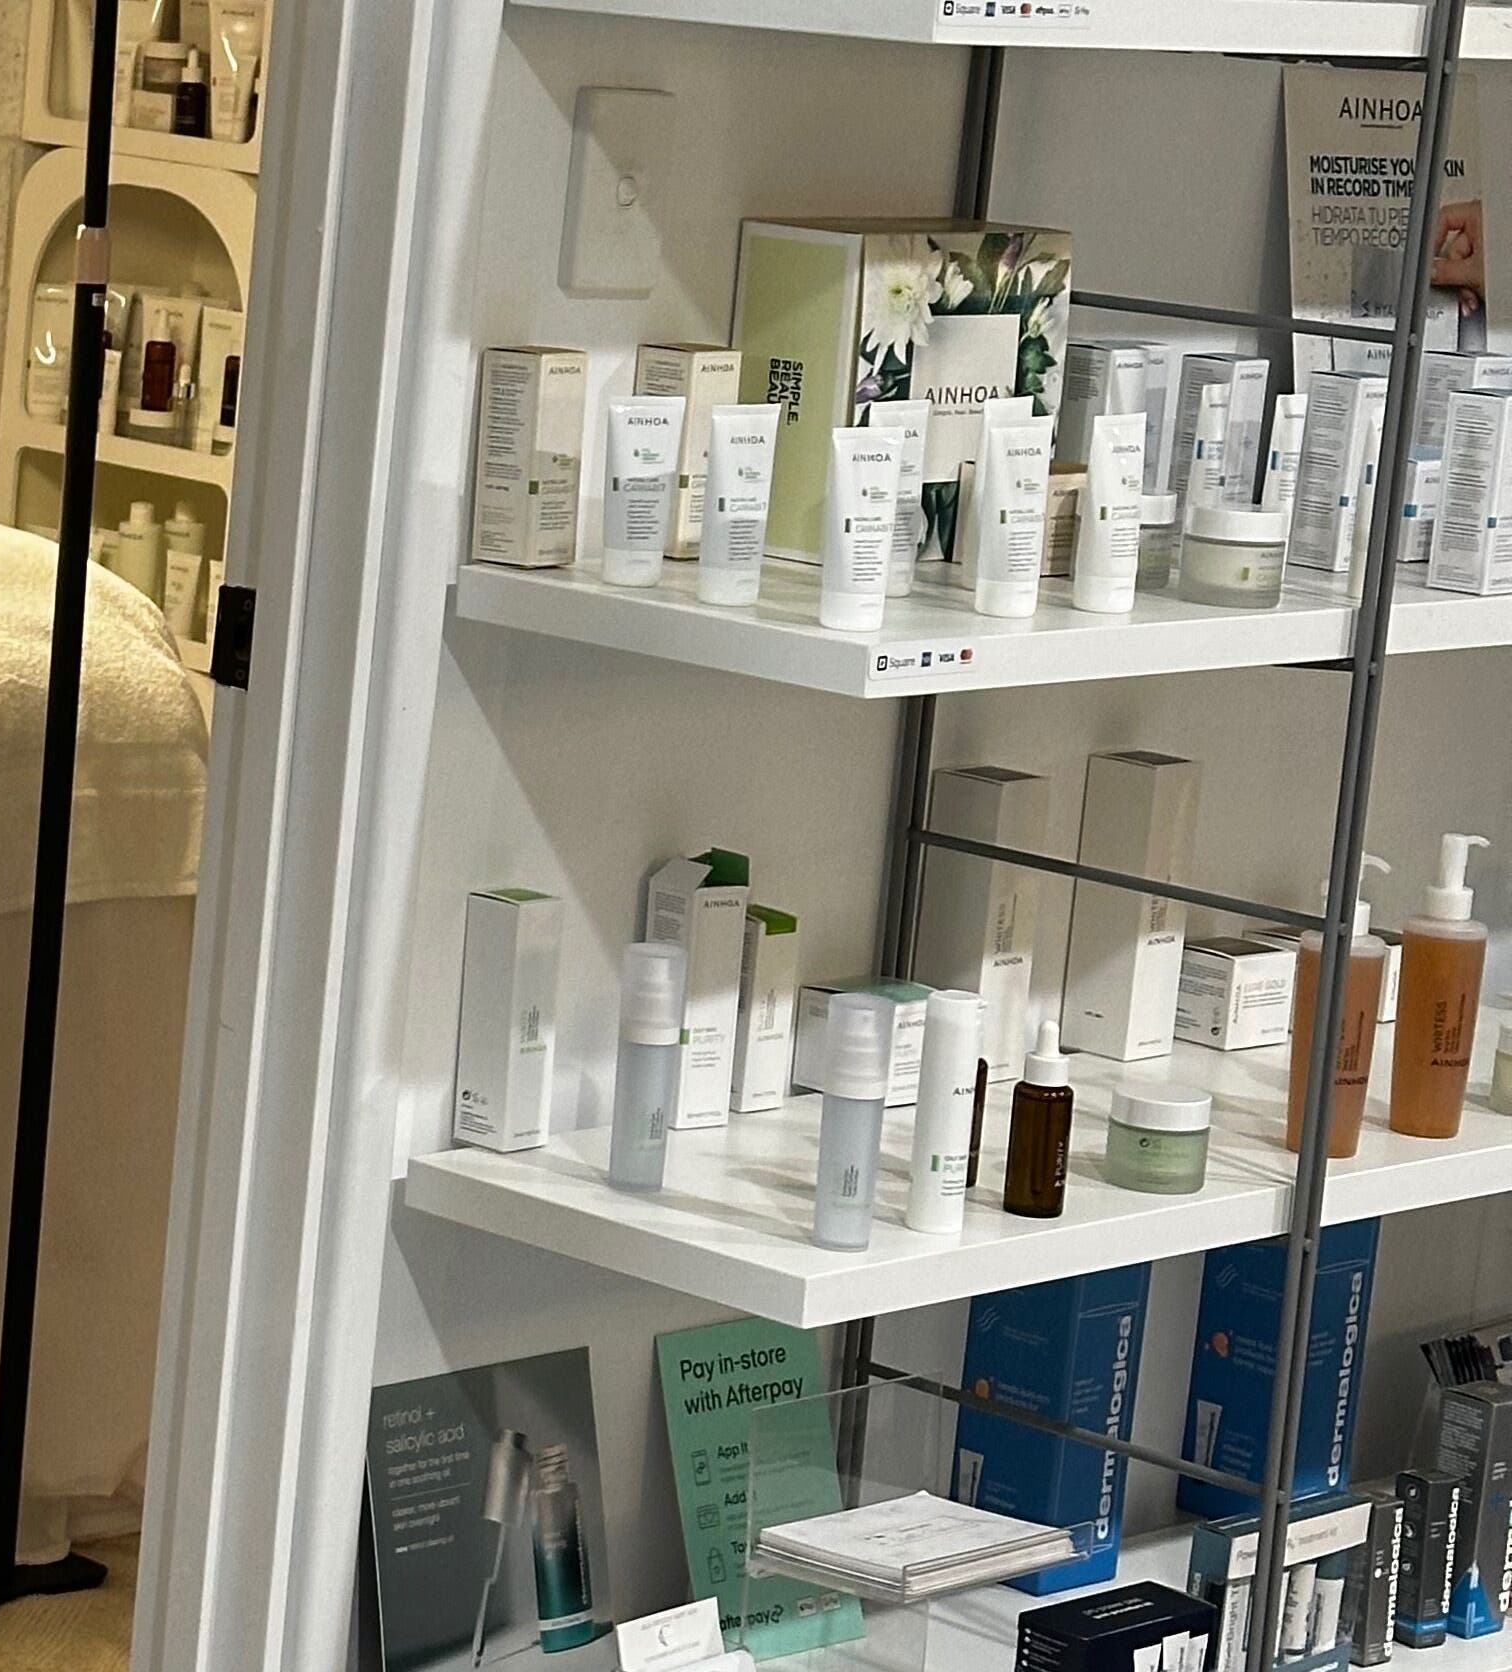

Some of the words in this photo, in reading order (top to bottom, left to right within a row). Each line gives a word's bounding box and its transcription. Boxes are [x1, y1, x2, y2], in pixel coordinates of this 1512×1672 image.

[1339, 97, 1424, 122] AINHOA
[1309, 155, 1387, 176] MOISTURISE
[1310, 177, 1325, 196] IN
[1326, 177, 1381, 198] RECORD
[548, 365, 582, 376] AINHOA
[701, 363, 735, 374] AINHOA
[924, 385, 1000, 406] AINHOA
[627, 417, 670, 426] AINHOA
[730, 435, 766, 445] AINHOA
[852, 453, 892, 463] AINHOA
[1007, 447, 1042, 457] AINHOA
[679, 1357, 715, 1383] Pay
[718, 1345, 787, 1375] in-store
[1326, 1271, 1364, 1488] dermalogica
[684, 1388, 722, 1416] with
[726, 1376, 804, 1406] Afterpay
[383, 1404, 422, 1429] retinol
[386, 1429, 436, 1455] salicylic
[438, 1420, 465, 1445] acid
[1096, 1314, 1132, 1541] dermalogica
[716, 1444, 740, 1461] App
[724, 1491, 747, 1507] Add
[1440, 1487, 1461, 1614] dermalogica
[1383, 1507, 1404, 1658] dermalogica
